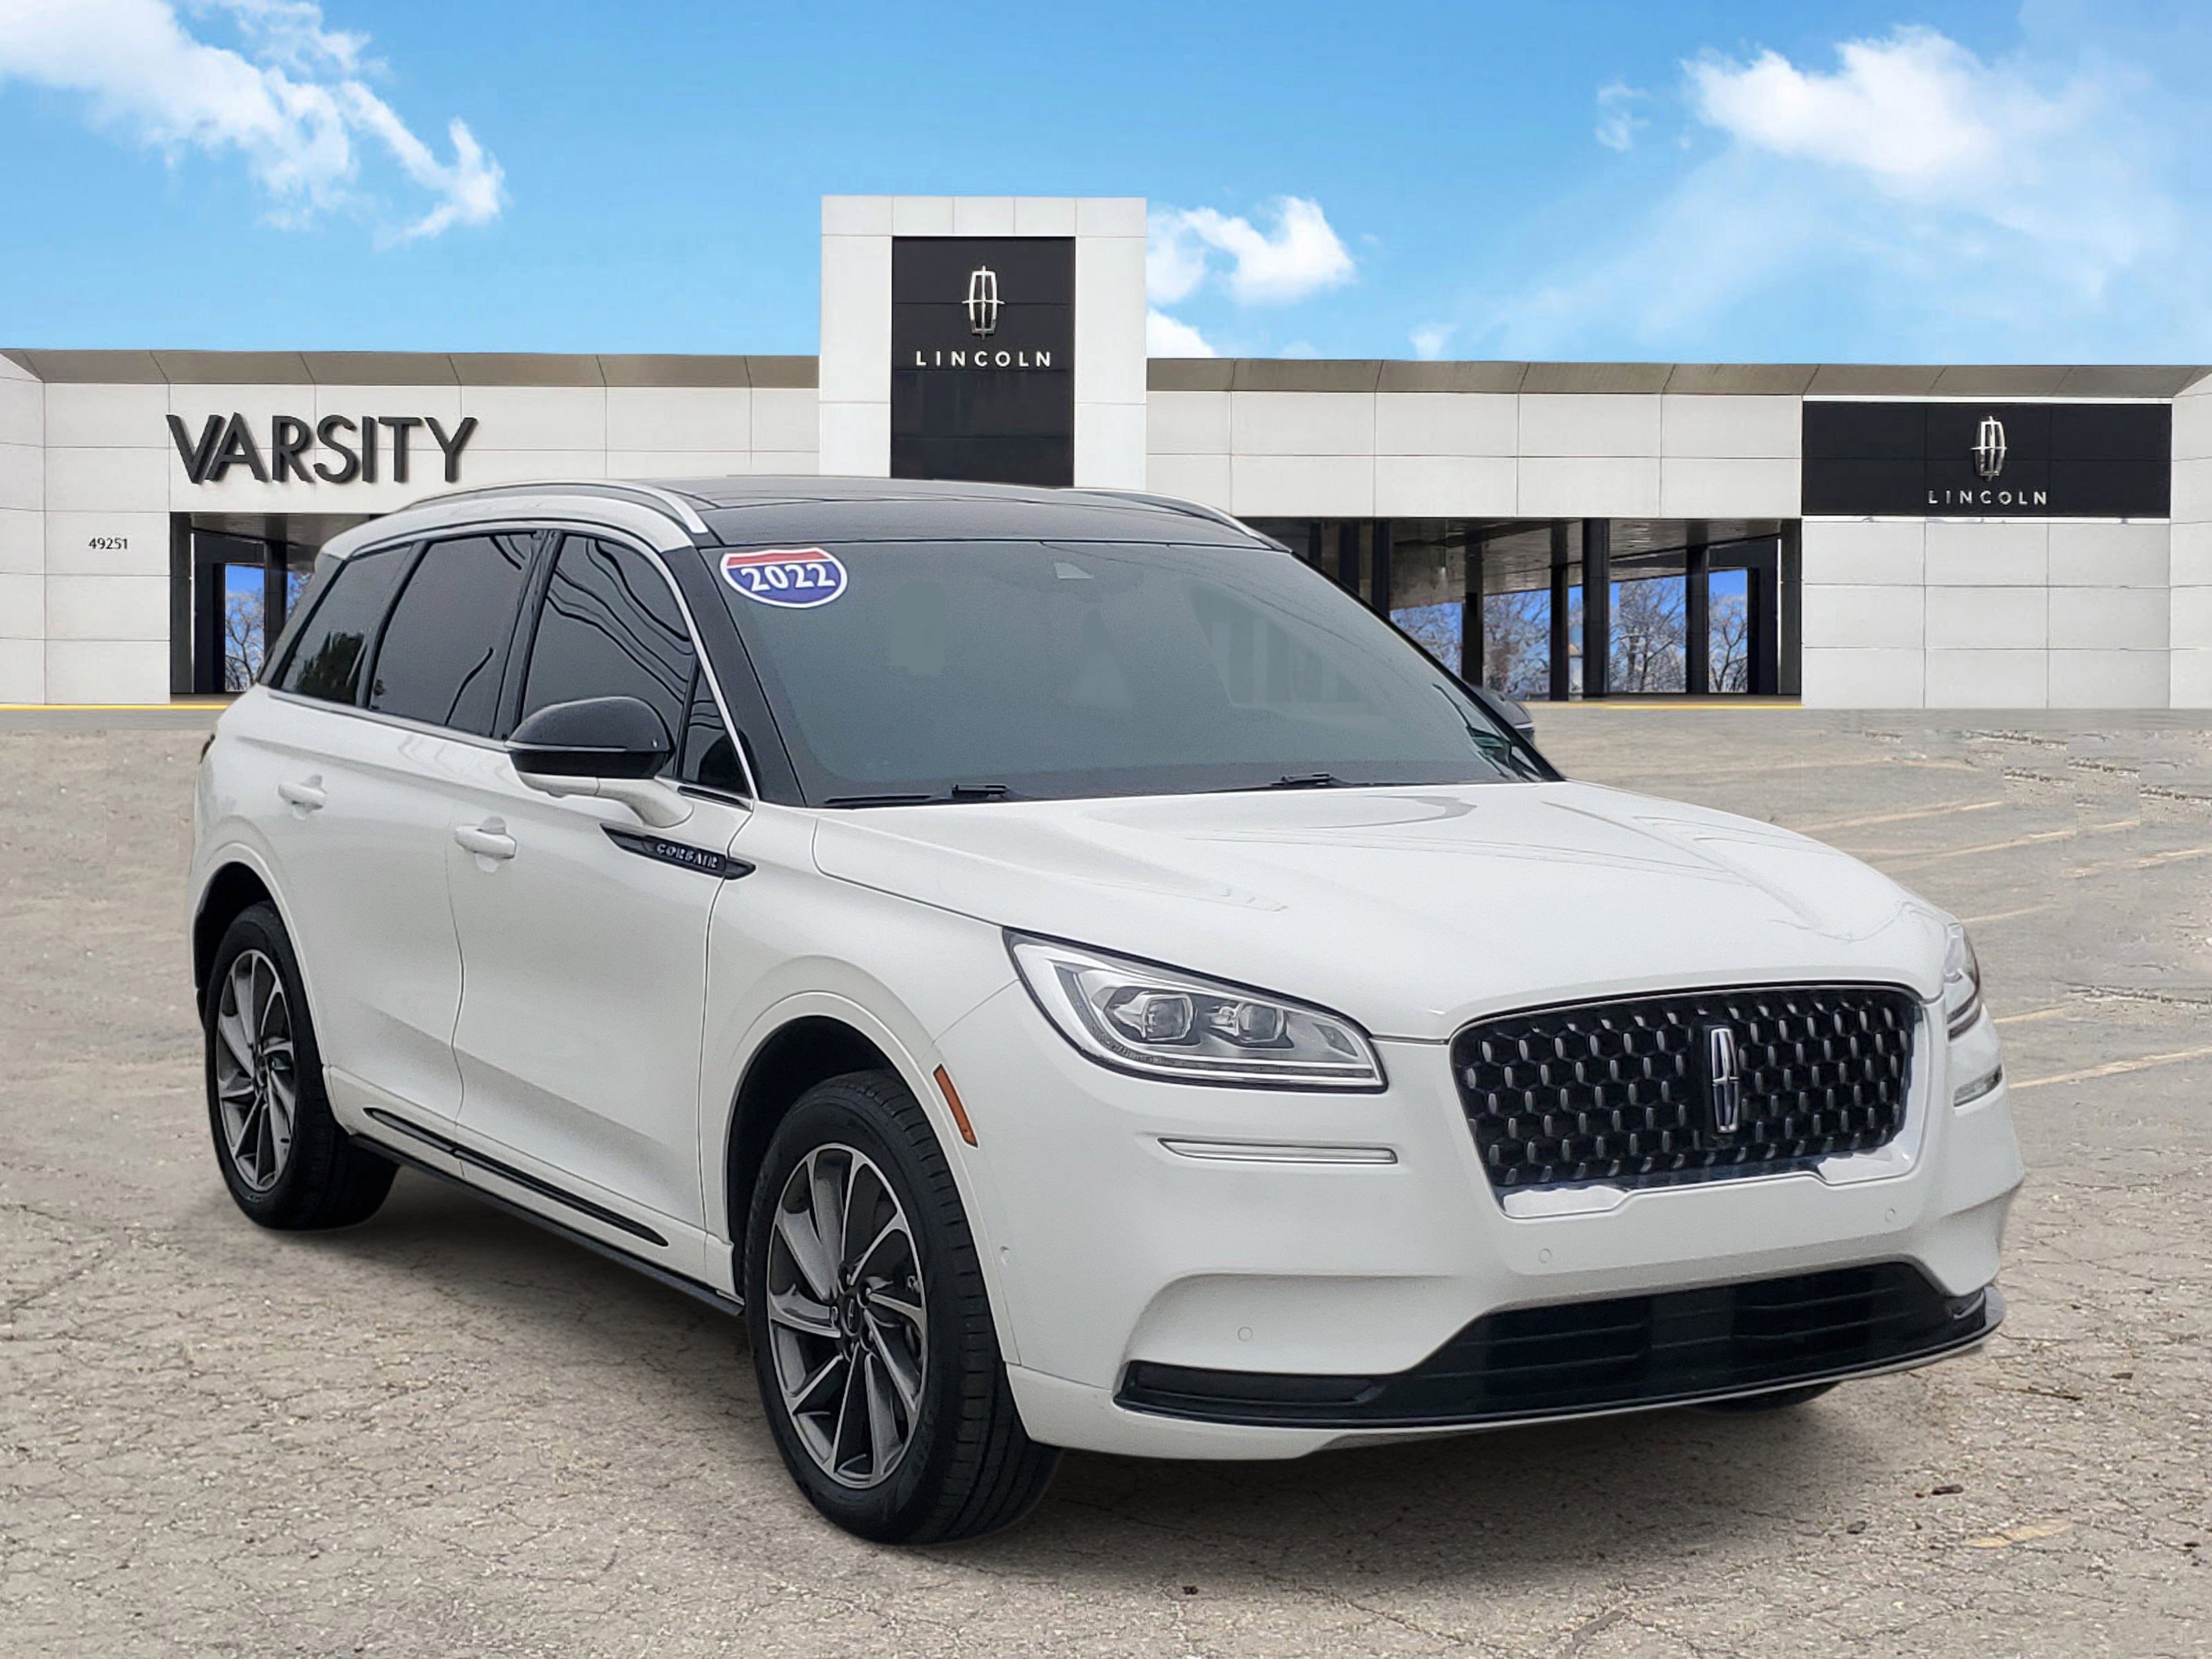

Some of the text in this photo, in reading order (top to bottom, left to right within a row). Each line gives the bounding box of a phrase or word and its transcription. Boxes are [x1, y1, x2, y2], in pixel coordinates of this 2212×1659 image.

[915, 350, 1051, 367] LINCOLN
[166, 412, 478, 485] VARSITY
[1928, 490, 2047, 506] LINCOLN
[88, 537, 128, 550] 49251
[740, 563, 837, 592] 2022
[656, 843, 718, 868] CORSAIR
